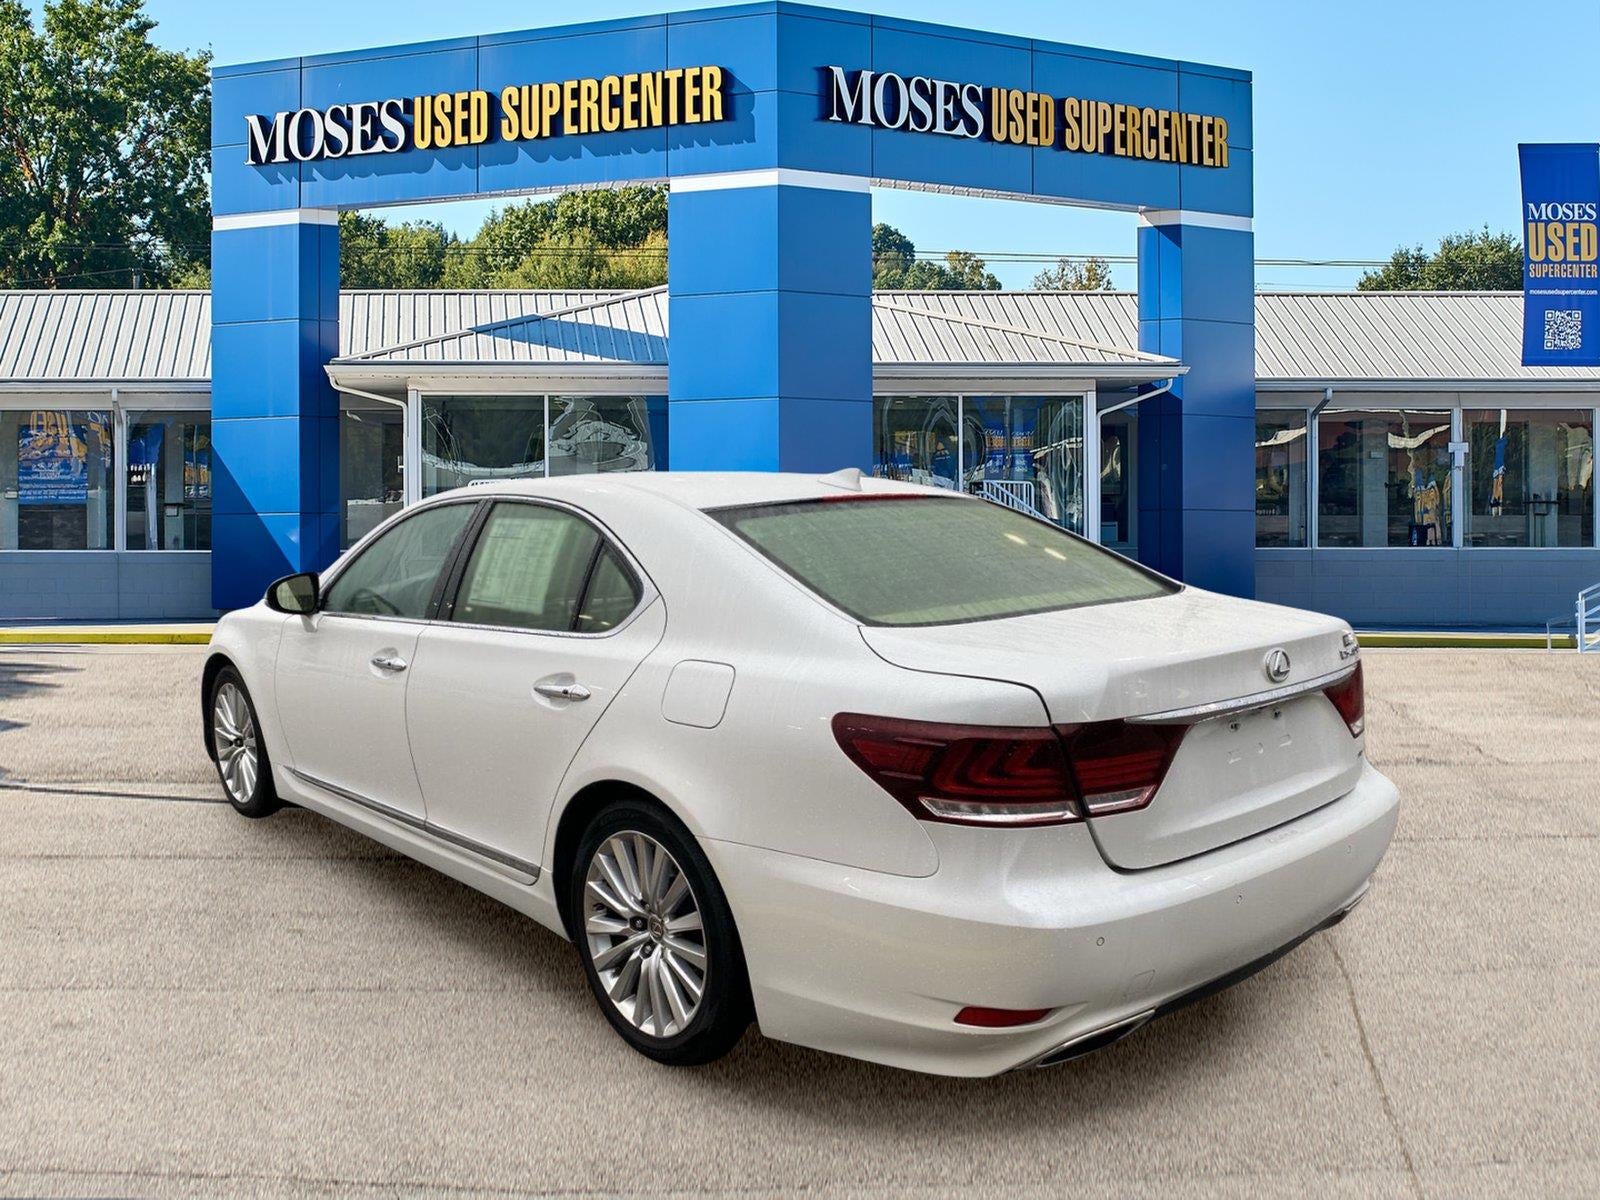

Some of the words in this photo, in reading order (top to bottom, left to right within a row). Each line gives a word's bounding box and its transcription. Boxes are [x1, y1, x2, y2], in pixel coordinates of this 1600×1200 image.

[244, 98, 406, 166] MOSES
[413, 90, 489, 150] USED
[501, 65, 724, 141] SUPERCENTER
[828, 65, 985, 139] MOSES
[991, 87, 1055, 147] USED
[1065, 96, 1229, 168] SUPERCENTER
[1527, 203, 1597, 221] MOSES
[1528, 222, 1598, 262] USED
[1529, 263, 1598, 278] SUPERCENTER
